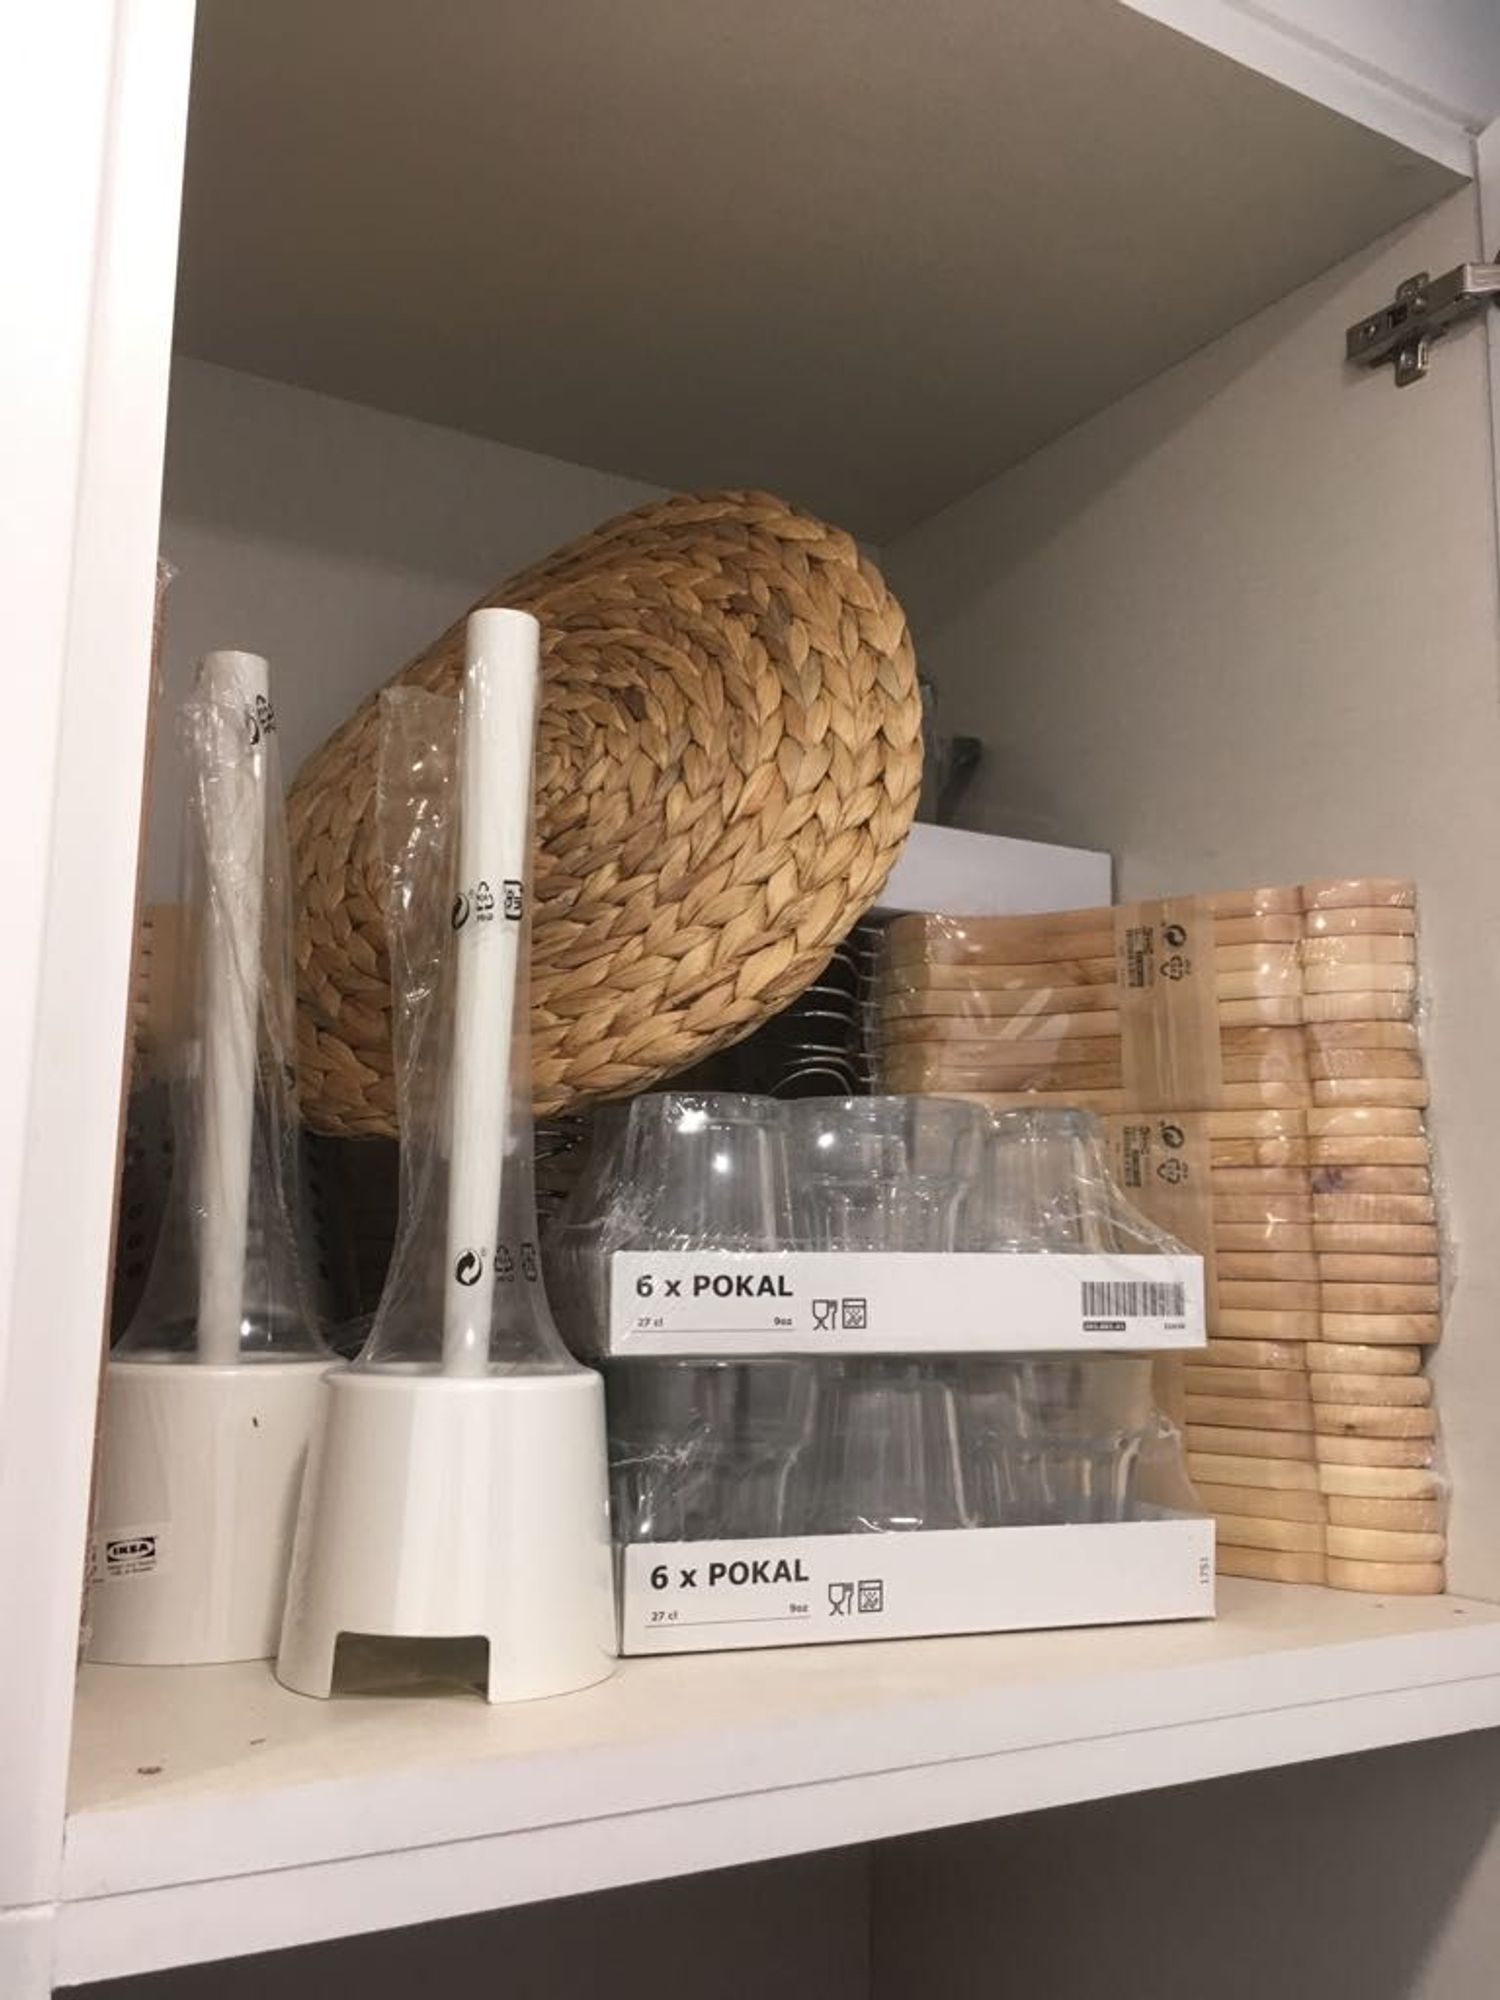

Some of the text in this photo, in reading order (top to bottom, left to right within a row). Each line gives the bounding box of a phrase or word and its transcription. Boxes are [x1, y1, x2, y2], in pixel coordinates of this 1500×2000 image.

[636, 1275, 793, 1297] 6 x POKAL
[650, 1558, 809, 1590] 6 x POKAL
[651, 1610, 665, 1622] 27
